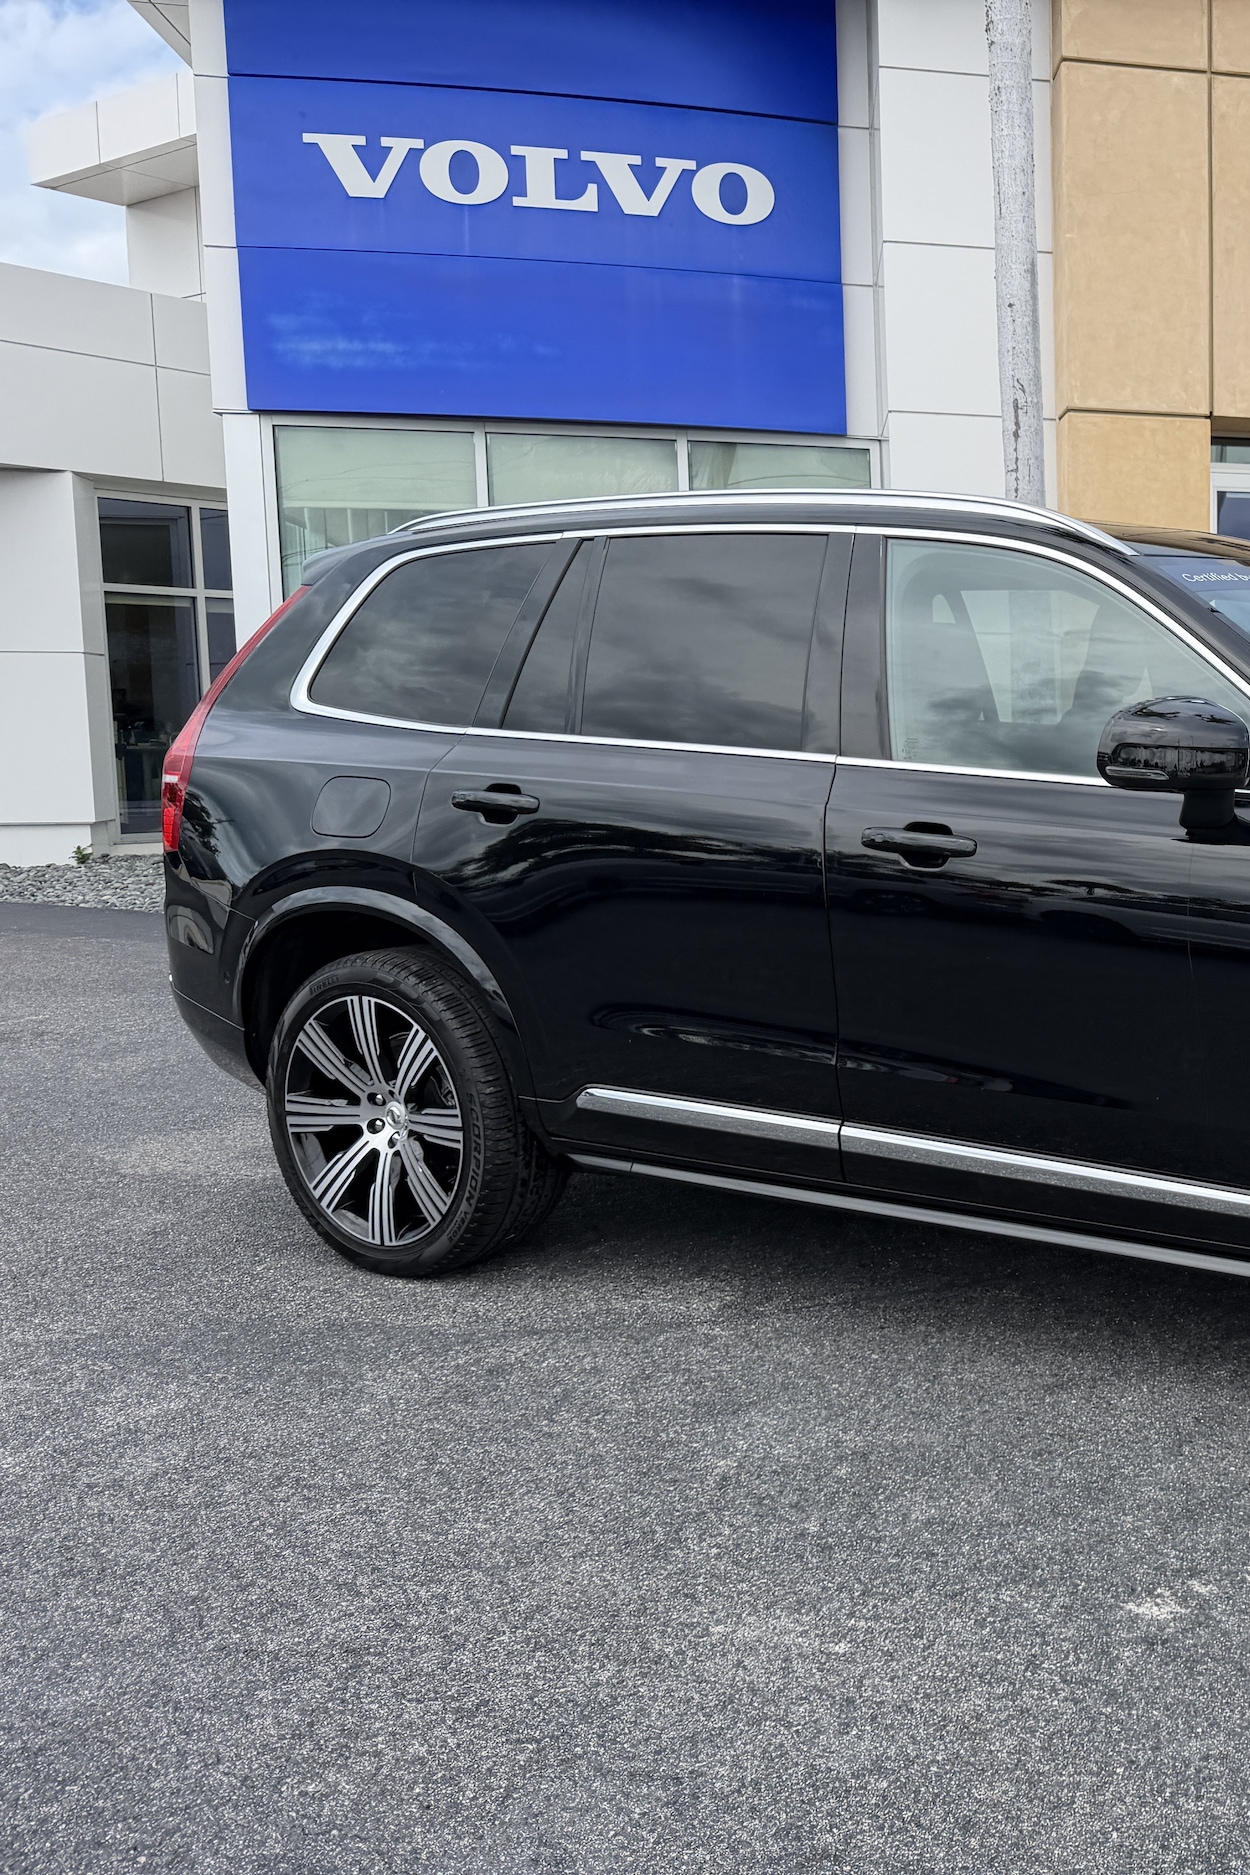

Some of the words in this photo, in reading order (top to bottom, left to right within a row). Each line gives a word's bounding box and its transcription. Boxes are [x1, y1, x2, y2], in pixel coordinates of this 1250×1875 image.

[302, 132, 776, 226] VOLVO
[1181, 571, 1238, 583] Certified
[466, 1092, 481, 1208] SCORPION
